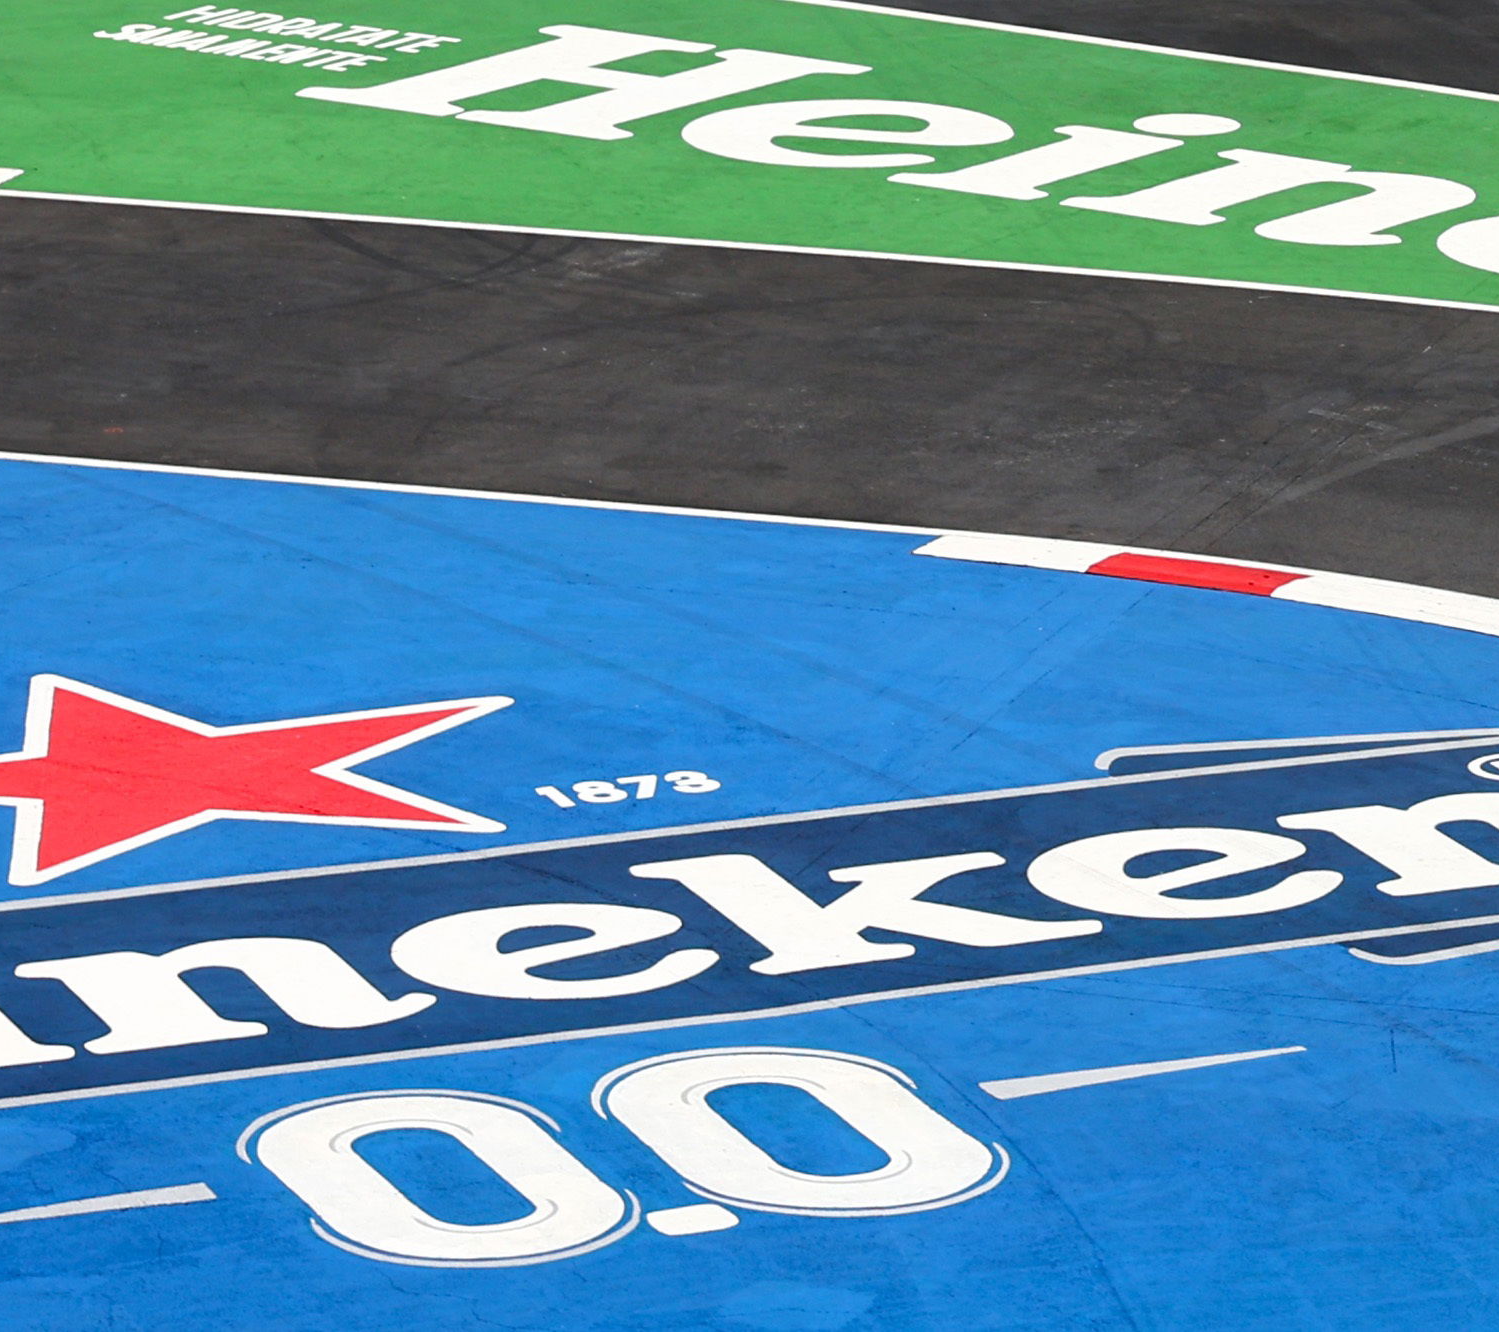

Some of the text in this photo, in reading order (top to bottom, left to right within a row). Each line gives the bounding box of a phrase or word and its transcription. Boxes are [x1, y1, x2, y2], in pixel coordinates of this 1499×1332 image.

[93, 23, 388, 72] SANAMENTE
[164, 5, 462, 54] HIDRATATE
[535, 771, 720, 807] 1873
[237, 1042, 1010, 1271] 0.0
